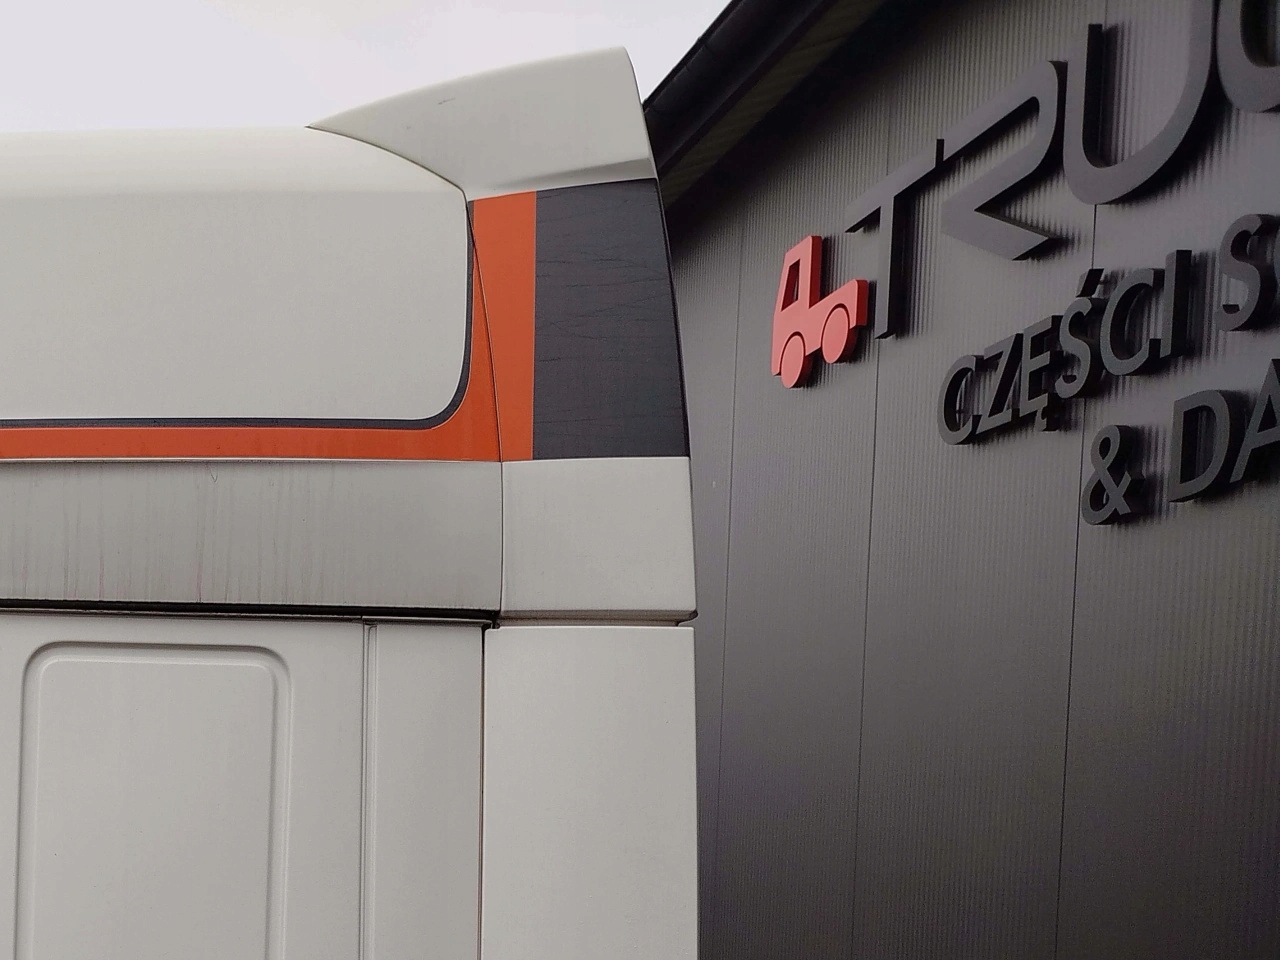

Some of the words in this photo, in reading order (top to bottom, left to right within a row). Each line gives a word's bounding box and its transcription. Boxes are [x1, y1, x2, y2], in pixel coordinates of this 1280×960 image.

[845, 0, 1280, 339] TRU
[937, 250, 1188, 445] CZĘŚCI
[1219, 213, 1280, 331] S
[1082, 425, 1140, 525] &
